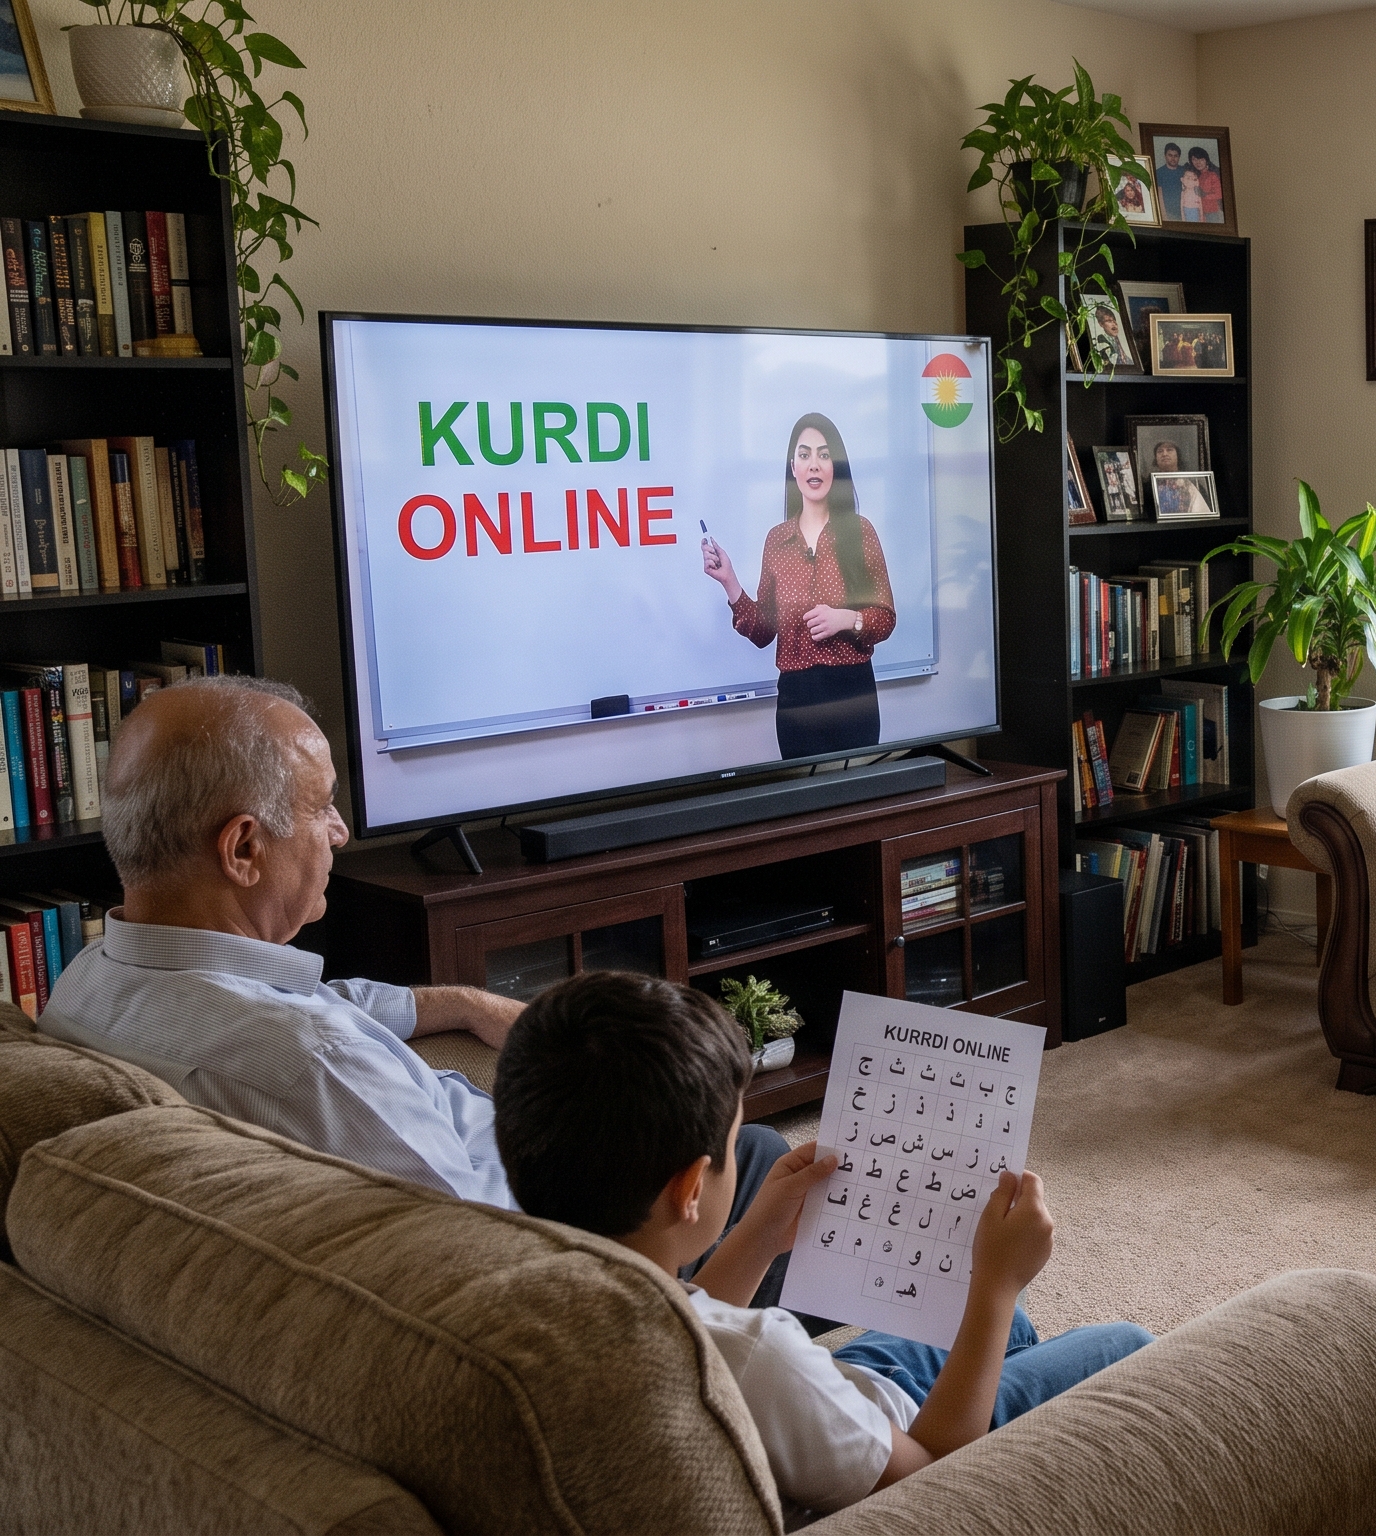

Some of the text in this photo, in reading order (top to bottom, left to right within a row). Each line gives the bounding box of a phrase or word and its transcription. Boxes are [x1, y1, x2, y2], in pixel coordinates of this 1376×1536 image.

[418, 400, 650, 467] KURDI
[398, 486, 678, 561] ONLINE
[883, 1024, 1011, 1064] KURRDI ONLINE
[858, 1055, 874, 1077] ج
[978, 1080, 995, 1098] ب
[869, 1133, 897, 1147] ص
[901, 1134, 924, 1154] ش
[930, 1146, 954, 1161] س
[865, 1157, 883, 1179] ط
[895, 1168, 910, 1193] ع
[924, 1170, 942, 1193] ط
[908, 1249, 922, 1267] و
[938, 1253, 953, 1273] ن
